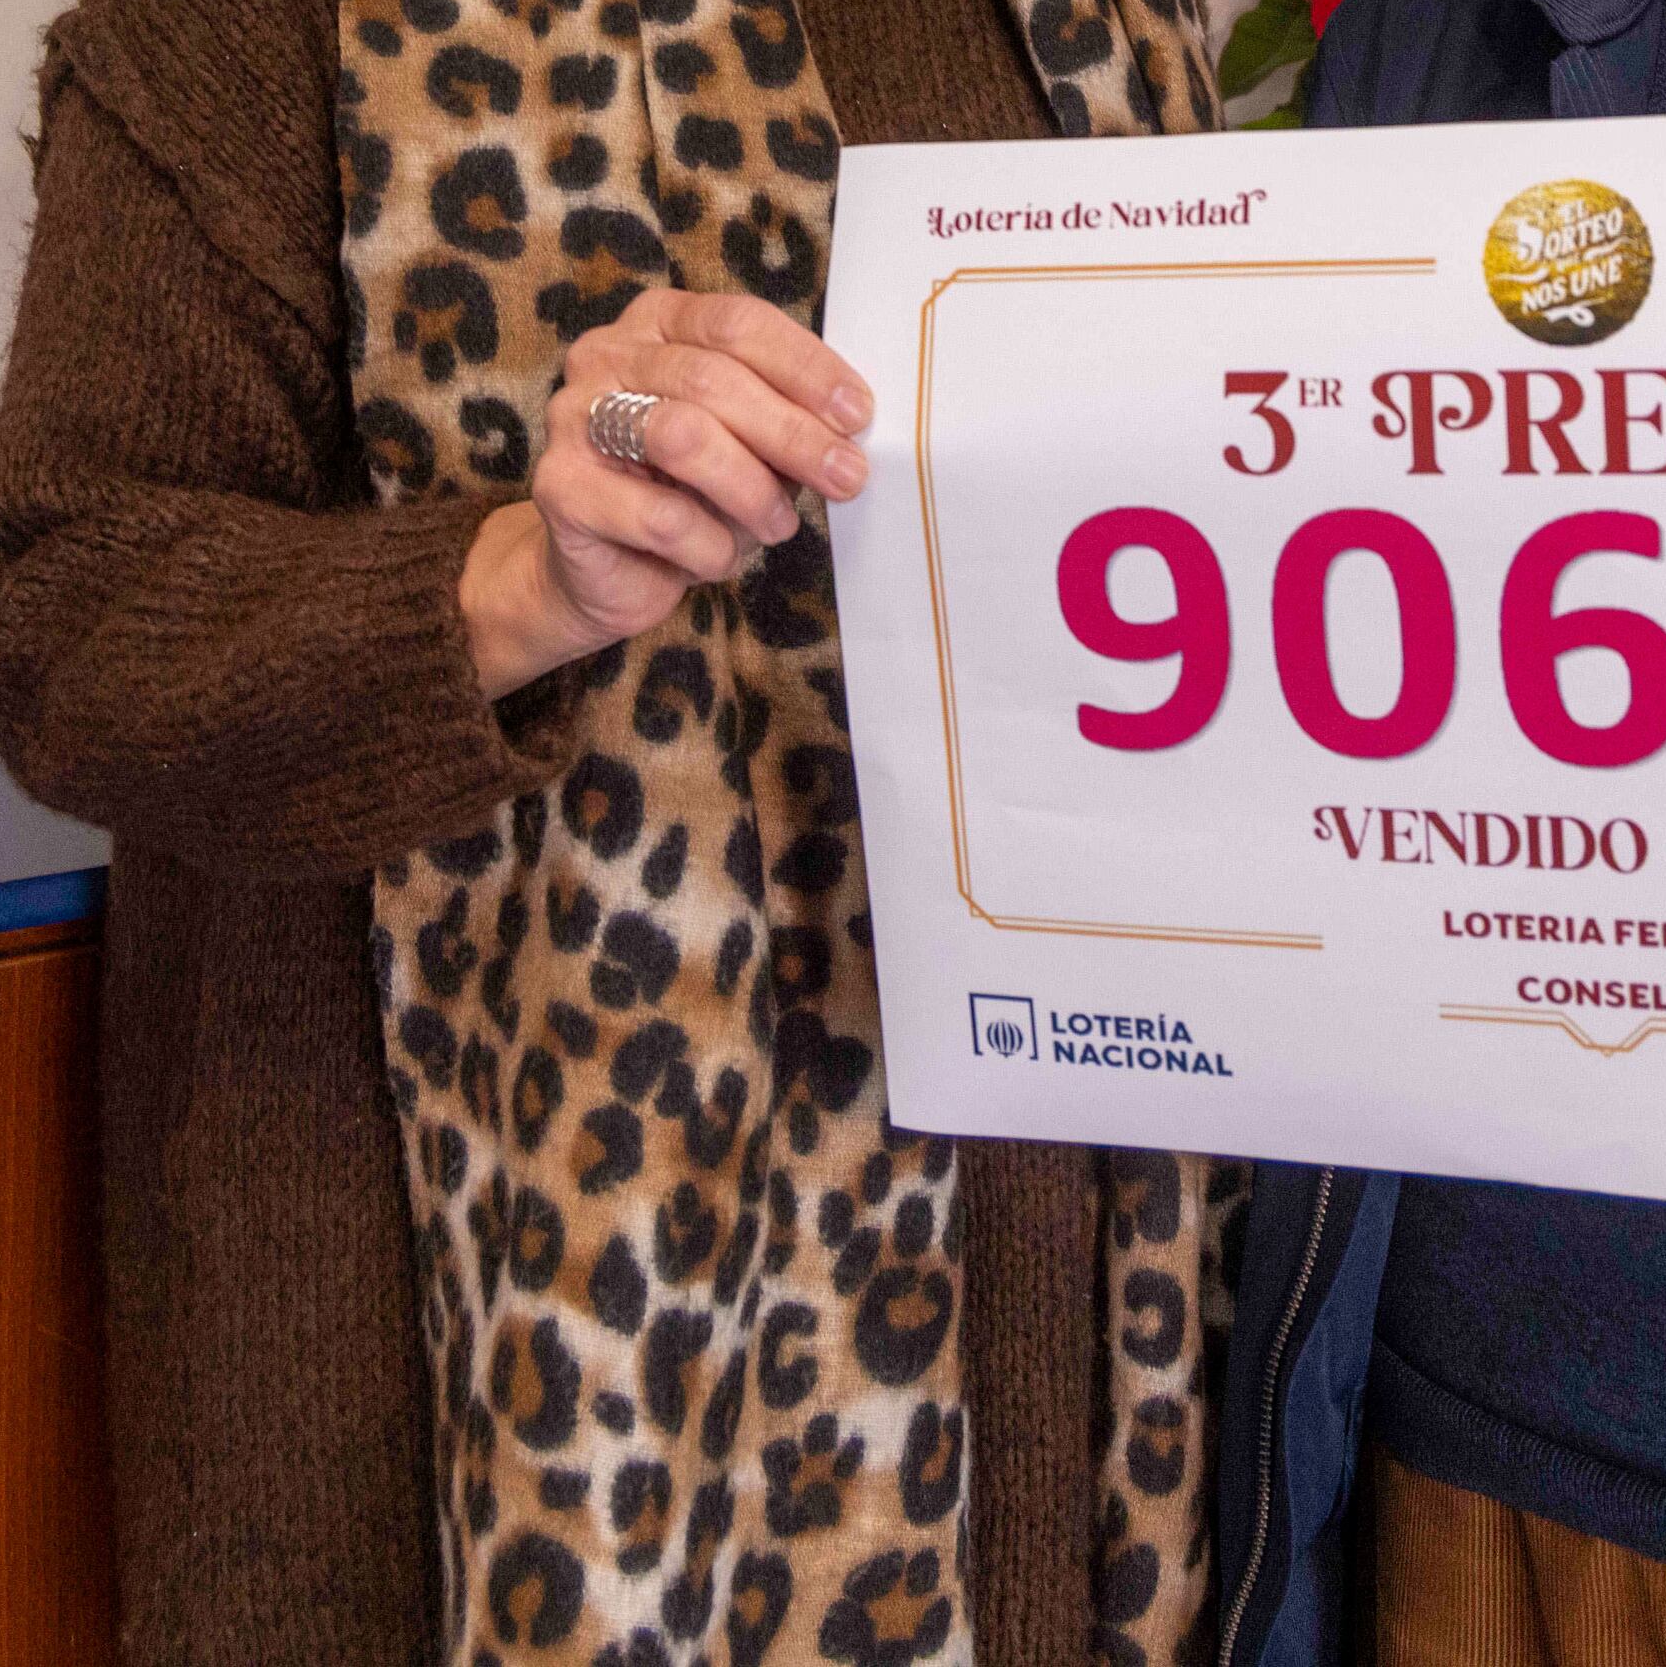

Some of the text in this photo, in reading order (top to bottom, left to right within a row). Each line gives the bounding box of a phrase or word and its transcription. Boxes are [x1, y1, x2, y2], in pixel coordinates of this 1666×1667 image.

[925, 187, 1269, 240] Lotería de Navidad
[1511, 205, 1624, 267] SORTEO
[1520, 253, 1625, 315] NOS UNE
[1312, 804, 1649, 875] VENDIDO
[1441, 909, 1606, 946] LOTERIA
[1049, 1010, 1194, 1045] LOTERÍA
[1053, 1039, 1234, 1078] NACIONAL
